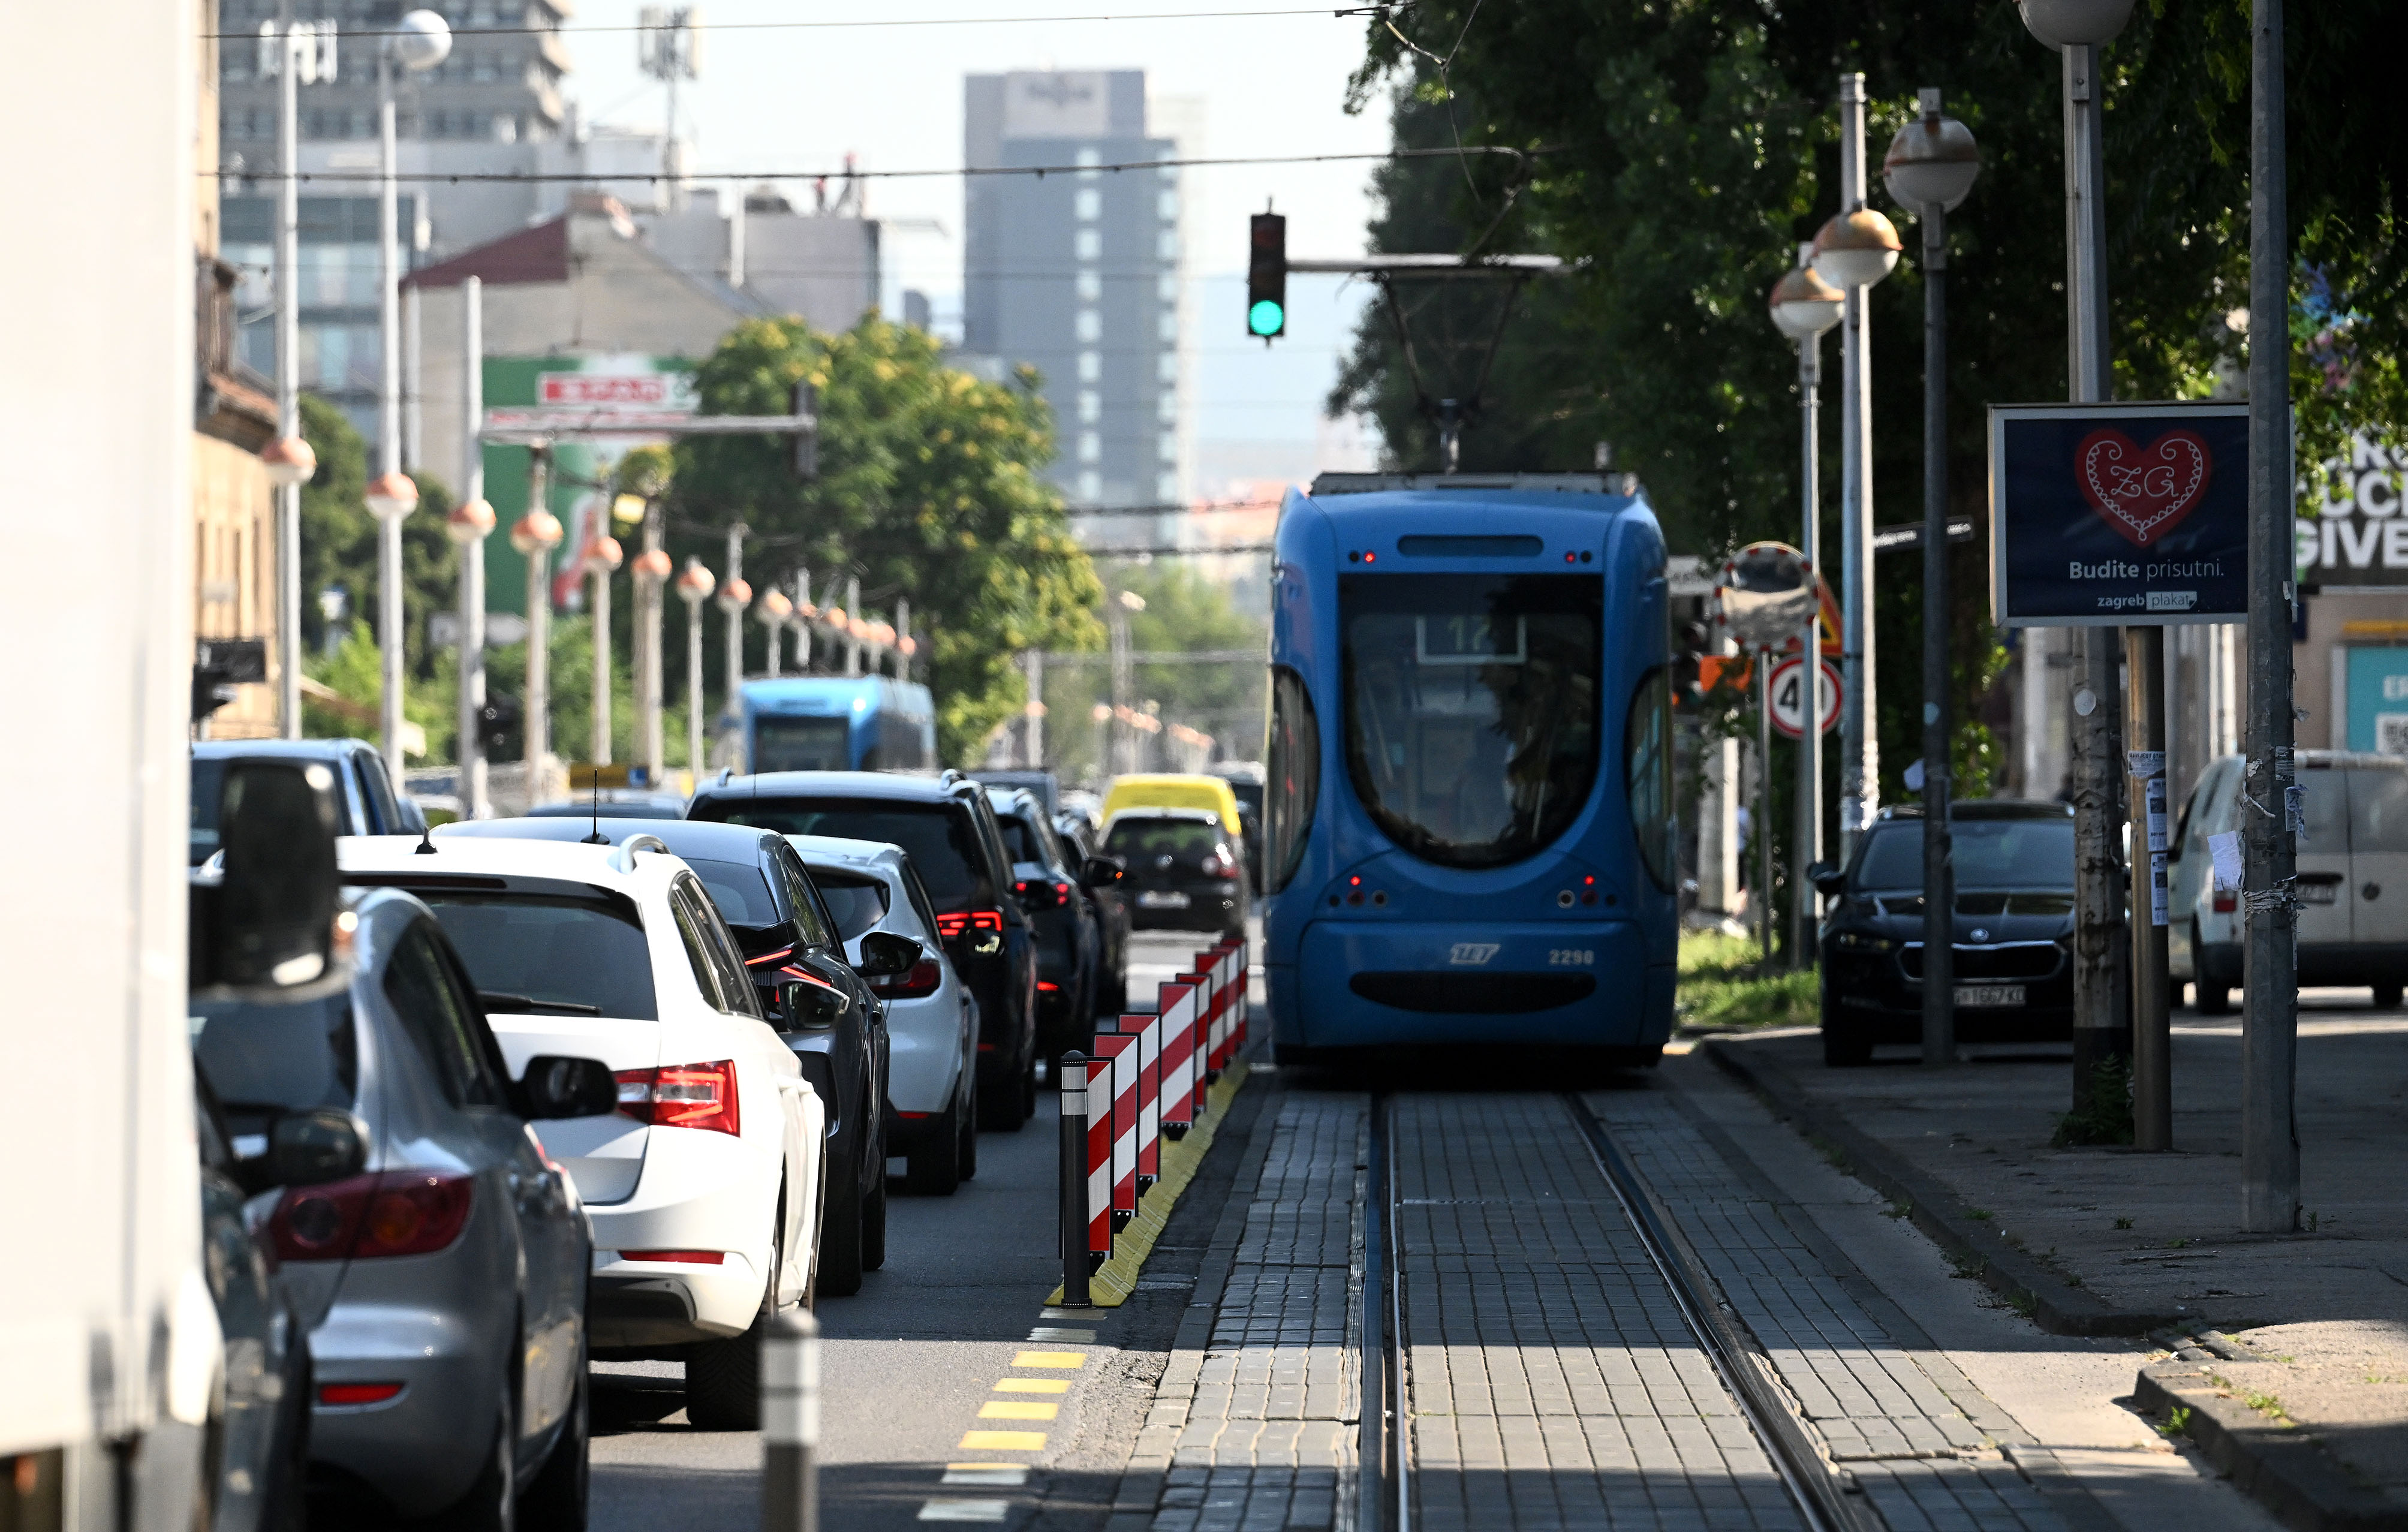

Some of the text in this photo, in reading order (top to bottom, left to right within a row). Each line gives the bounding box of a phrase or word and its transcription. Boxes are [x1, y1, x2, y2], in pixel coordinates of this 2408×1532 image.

[2111, 465, 2179, 497] ZG
[2070, 558, 2224, 582] Budite prisutni.
[2097, 591, 2190, 610] zagreb plakat
[1779, 676, 1825, 711] 4
